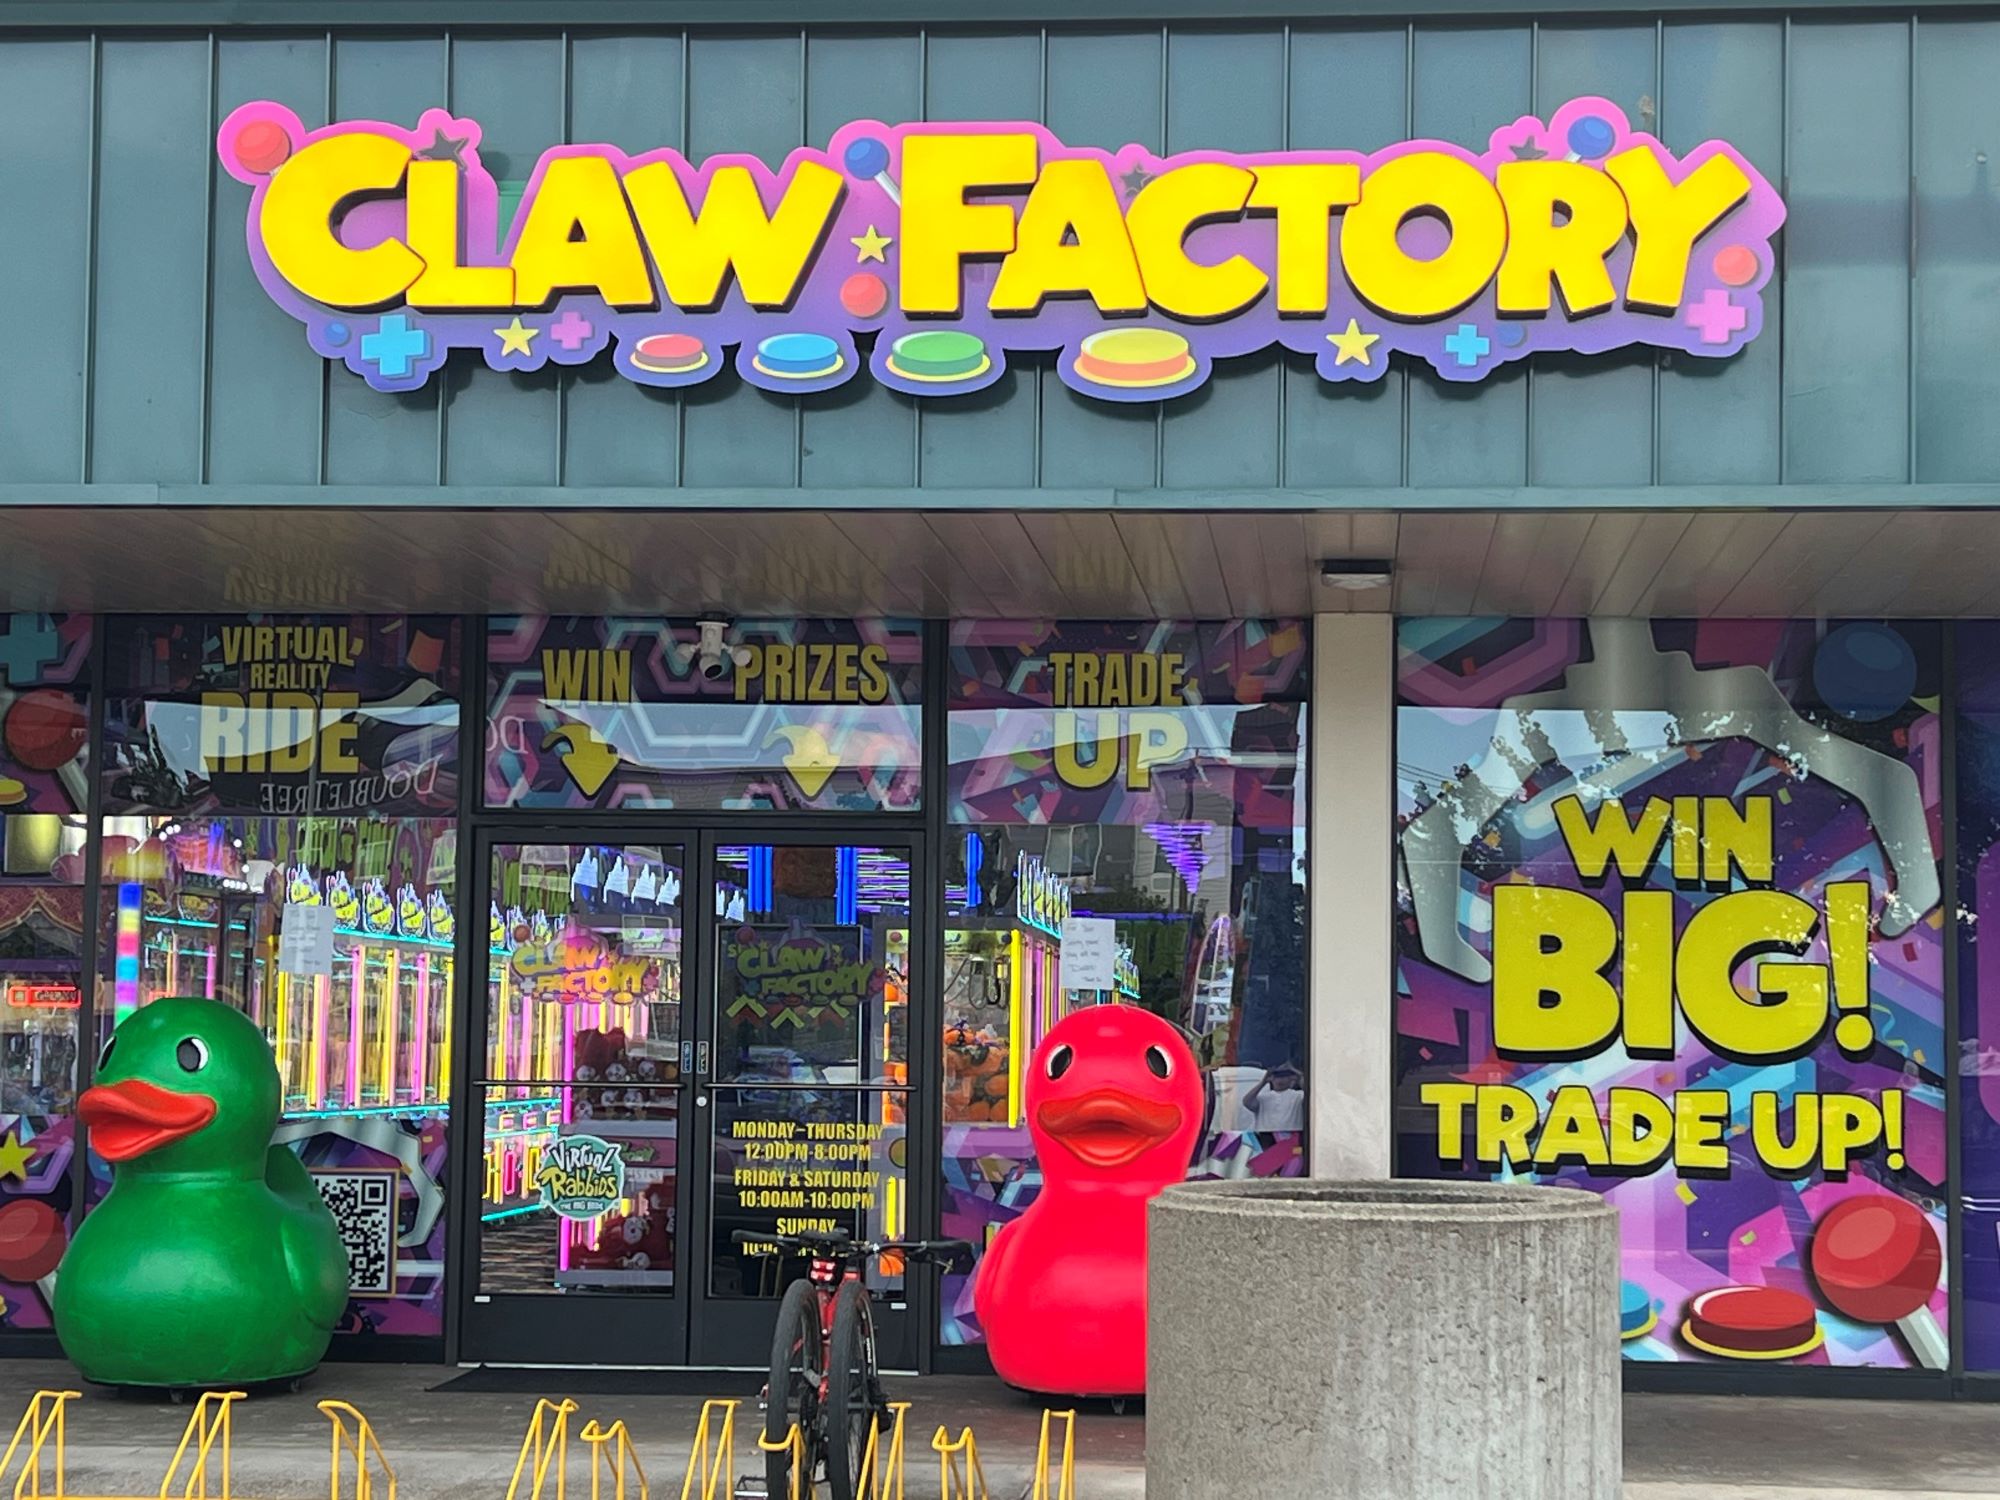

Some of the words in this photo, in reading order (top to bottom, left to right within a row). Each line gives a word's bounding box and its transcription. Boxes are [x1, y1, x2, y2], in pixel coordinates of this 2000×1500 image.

[259, 131, 846, 314] CLAW
[899, 133, 1752, 320] FACTORY
[220, 625, 355, 667] VIRTUAL
[250, 662, 332, 690] REALITY
[541, 648, 633, 704] WIN
[733, 643, 890, 704] PRIZES
[1049, 652, 1184, 707] TRADE
[200, 690, 360, 774] RIDE
[1053, 710, 1189, 790] UP
[1552, 794, 1774, 887] WIN
[537, 957, 651, 994] FACTORY
[737, 944, 827, 978] CLAW
[761, 960, 875, 996] FACTORY
[1492, 881, 1877, 1062] BIG!
[743, 1142, 872, 1161] 12:00PM-8:00PM
[1420, 1083, 1731, 1178] TRADE
[1751, 1089, 1906, 1180] UP!
[734, 1168, 787, 1187] FRIDAY
[788, 1171, 801, 1187] &
[803, 1169, 881, 1188] SATURDAY
[737, 1190, 875, 1210] 10:00AM-10:00PM
